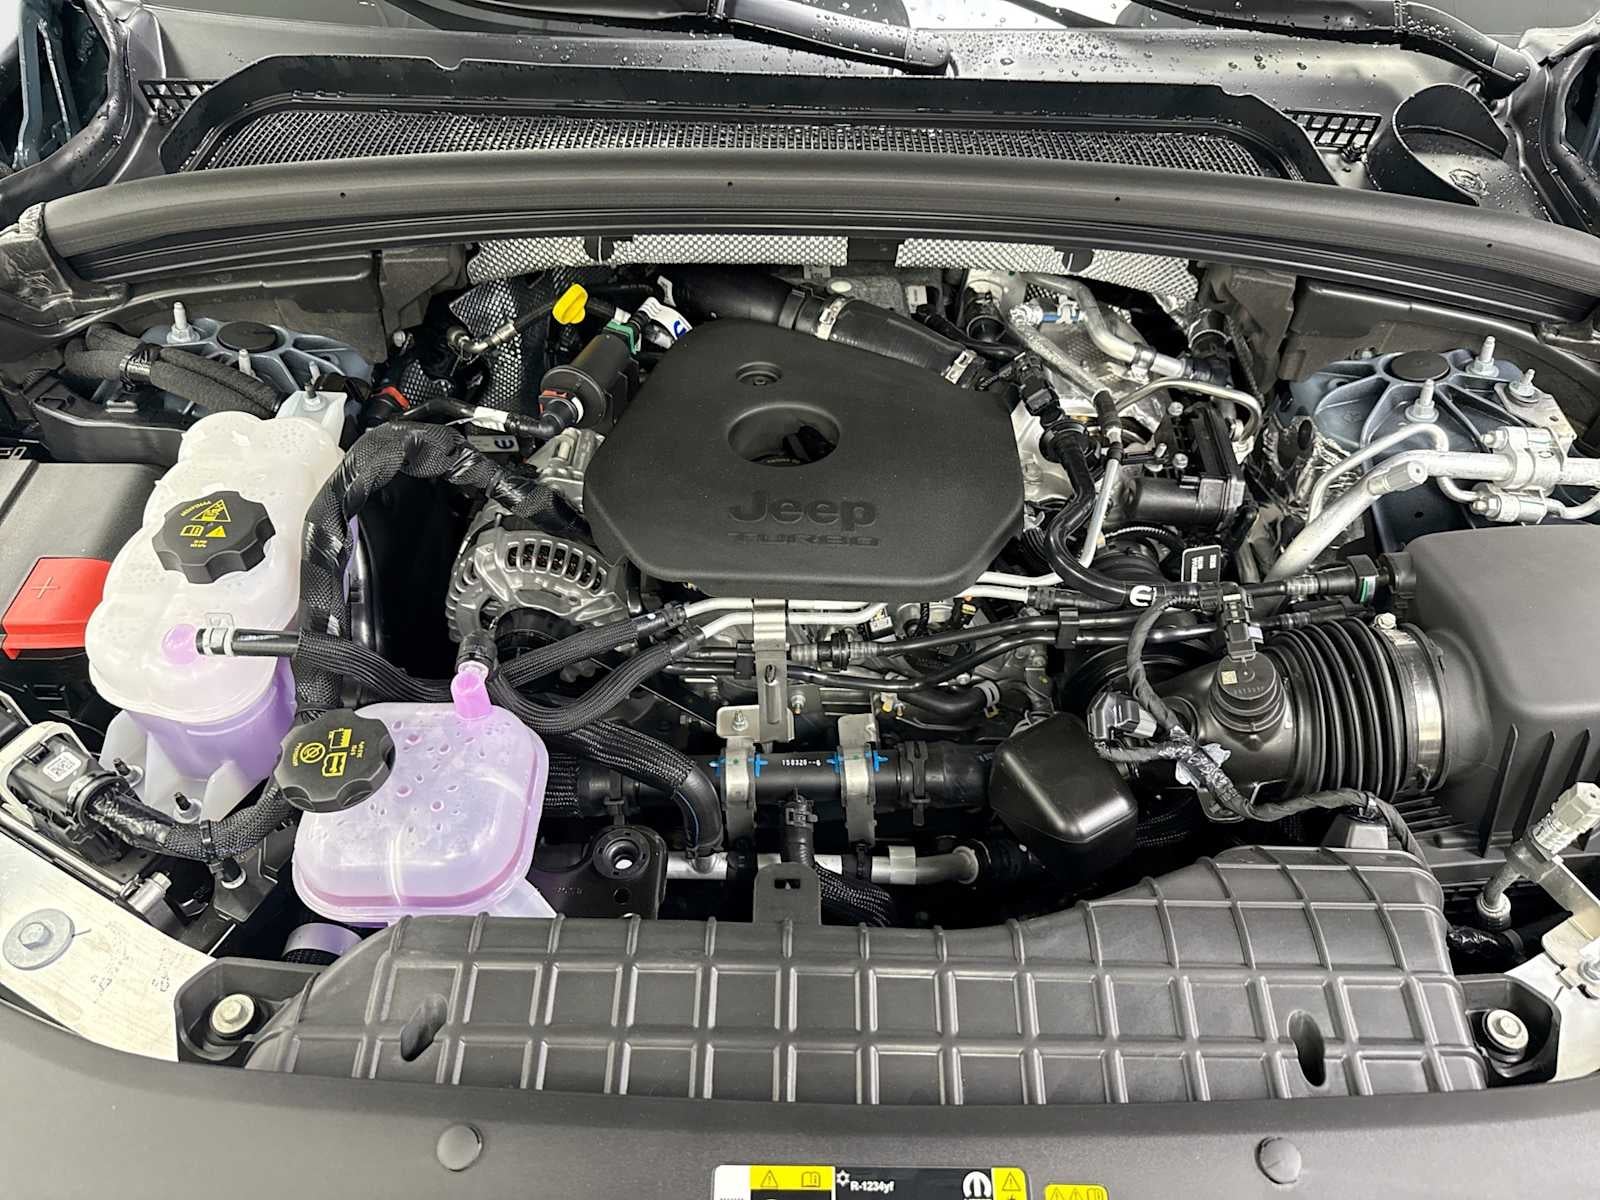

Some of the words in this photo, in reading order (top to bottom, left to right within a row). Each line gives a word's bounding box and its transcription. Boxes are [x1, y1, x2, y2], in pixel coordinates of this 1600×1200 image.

[728, 490, 877, 533] Jeep
[728, 532, 880, 549] TURBO
[849, 1180, 895, 1194] R-1234yf
